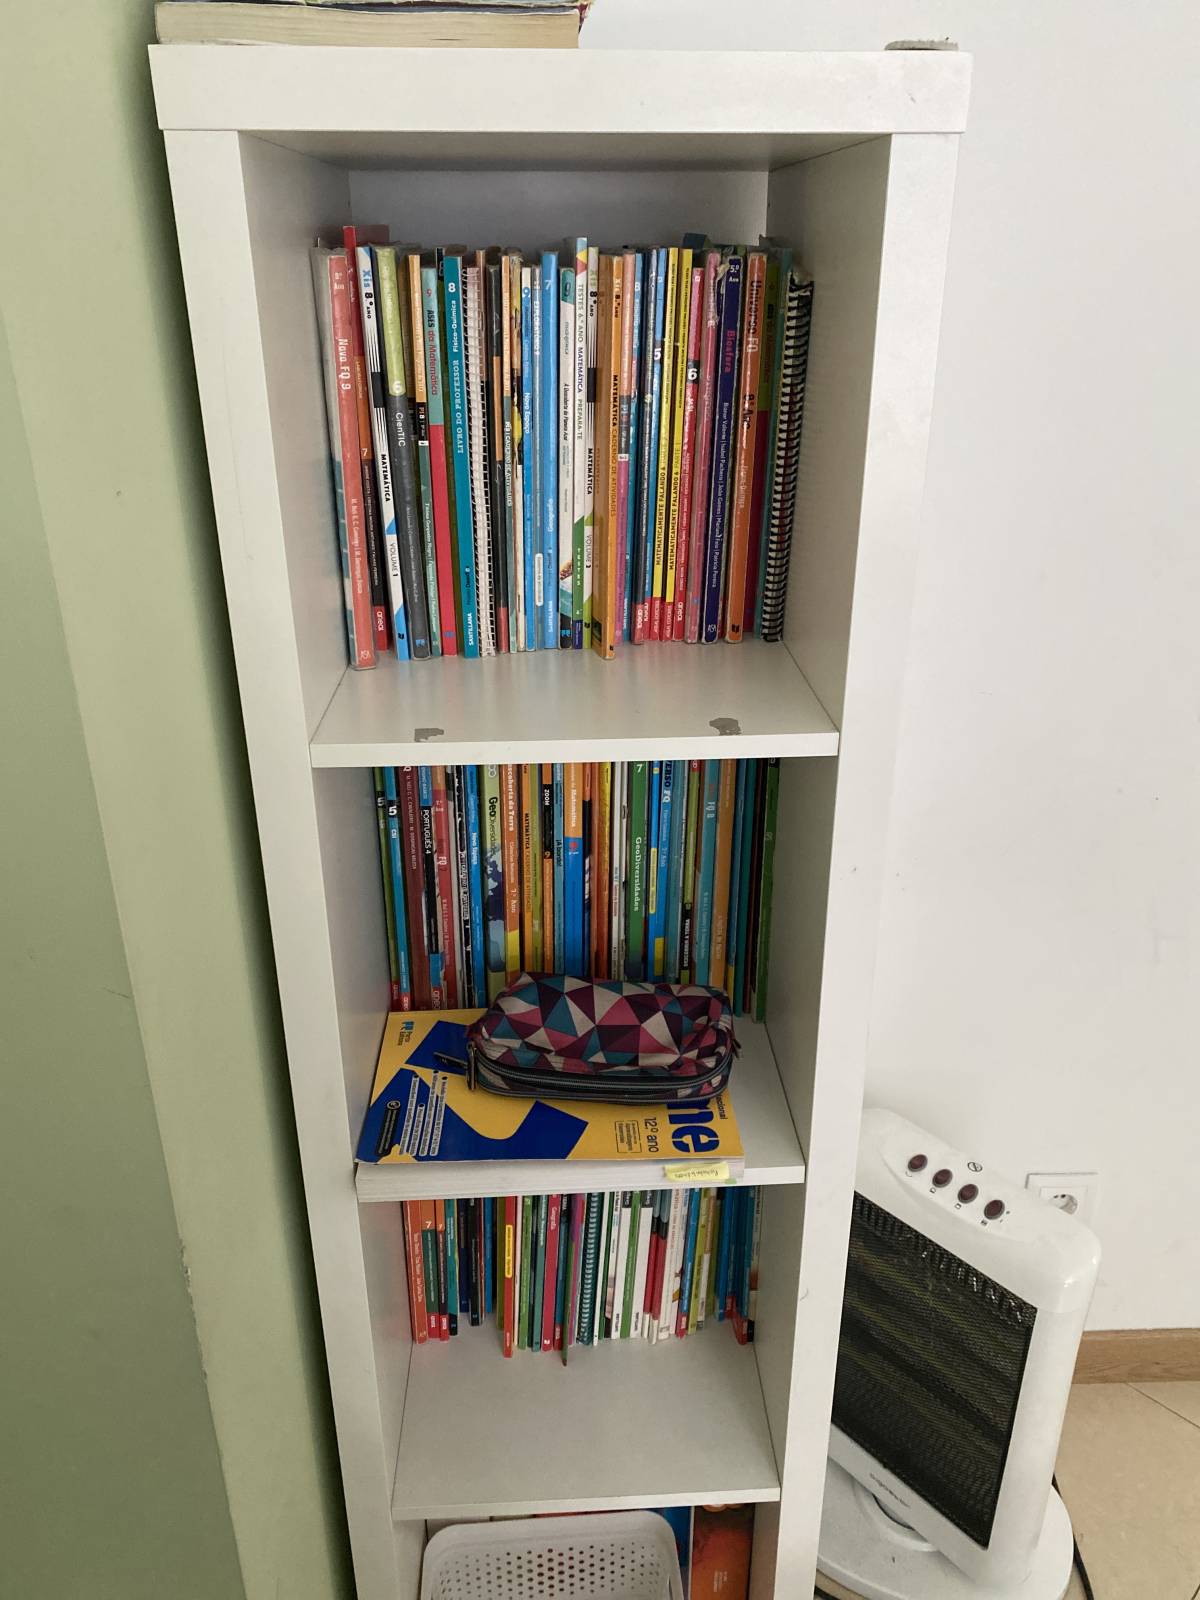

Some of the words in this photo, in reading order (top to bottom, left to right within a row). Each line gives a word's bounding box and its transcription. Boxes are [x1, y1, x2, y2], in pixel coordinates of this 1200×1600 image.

[730, 265, 740, 273] 5.º
[362, 270, 371, 288] Xis
[448, 282, 456, 293] 8
[544, 280, 552, 290] 7
[749, 280, 762, 334] Universo
[427, 310, 435, 328] ASES
[428, 330, 436, 341] da
[338, 339, 348, 362] Novo
[724, 330, 736, 373] Biosfera
[746, 338, 758, 352] FQ
[654, 348, 661, 360] 5
[340, 366, 350, 378] FQ
[429, 344, 438, 396] Matemática
[687, 368, 698, 380] 6
[453, 360, 462, 410] PROFESSOR
[455, 412, 463, 425] DO
[395, 412, 406, 447] CienTIC
[456, 427, 464, 453] LIVRO
[361, 448, 367, 456] 7
[381, 454, 391, 502] MATEMÁTICA
[611, 466, 617, 475] DE
[658, 473, 666, 502] FALANDO
[671, 477, 679, 506] FALANDO
[669, 508, 677, 570] MATEMATICAMENTE
[389, 542, 398, 572] VOLUME
[636, 764, 643, 773] 7
[663, 789, 671, 802] FQ
[388, 806, 398, 816] 5
[422, 809, 431, 848] PORTUGUÊS
[437, 856, 447, 865] FQ
[633, 837, 642, 911] GeoDiversidades
[647, 1135, 659, 1152] ano
[425, 1221, 432, 1229] 7
